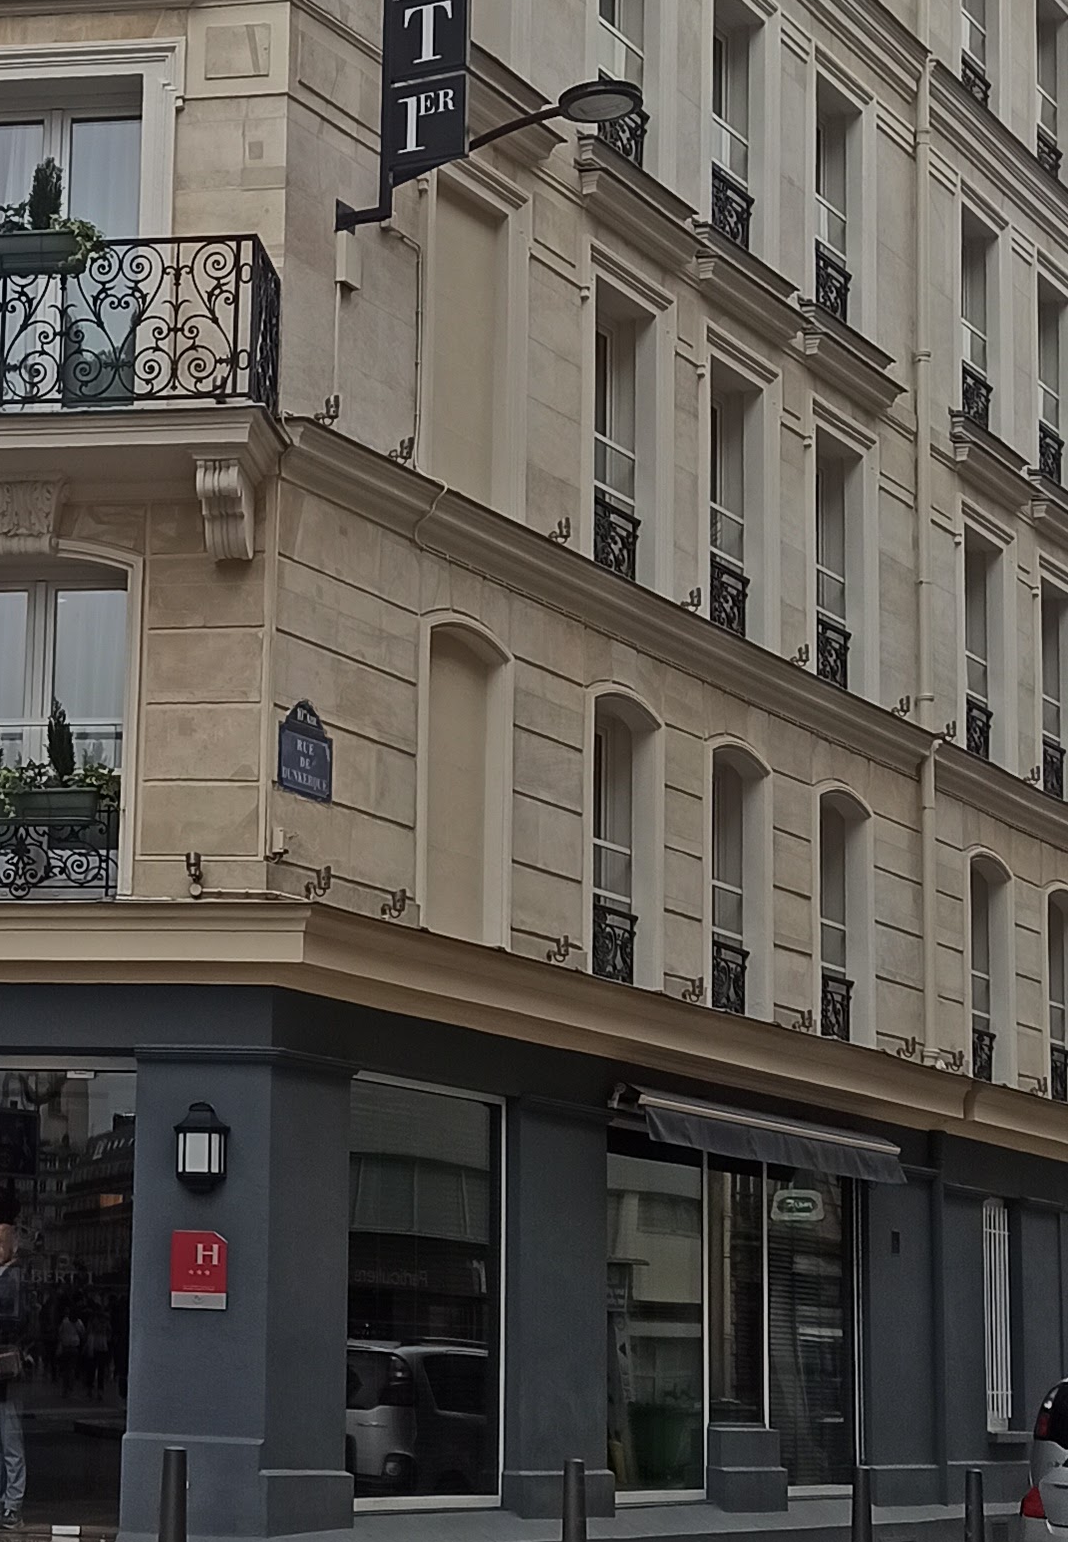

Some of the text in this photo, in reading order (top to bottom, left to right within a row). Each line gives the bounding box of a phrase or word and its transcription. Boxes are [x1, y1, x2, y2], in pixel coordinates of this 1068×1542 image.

[296, 739, 314, 756] RUE
[300, 756, 310, 770] DE
[282, 766, 327, 791] DUNKERQUE
[196, 1243, 219, 1265] H
